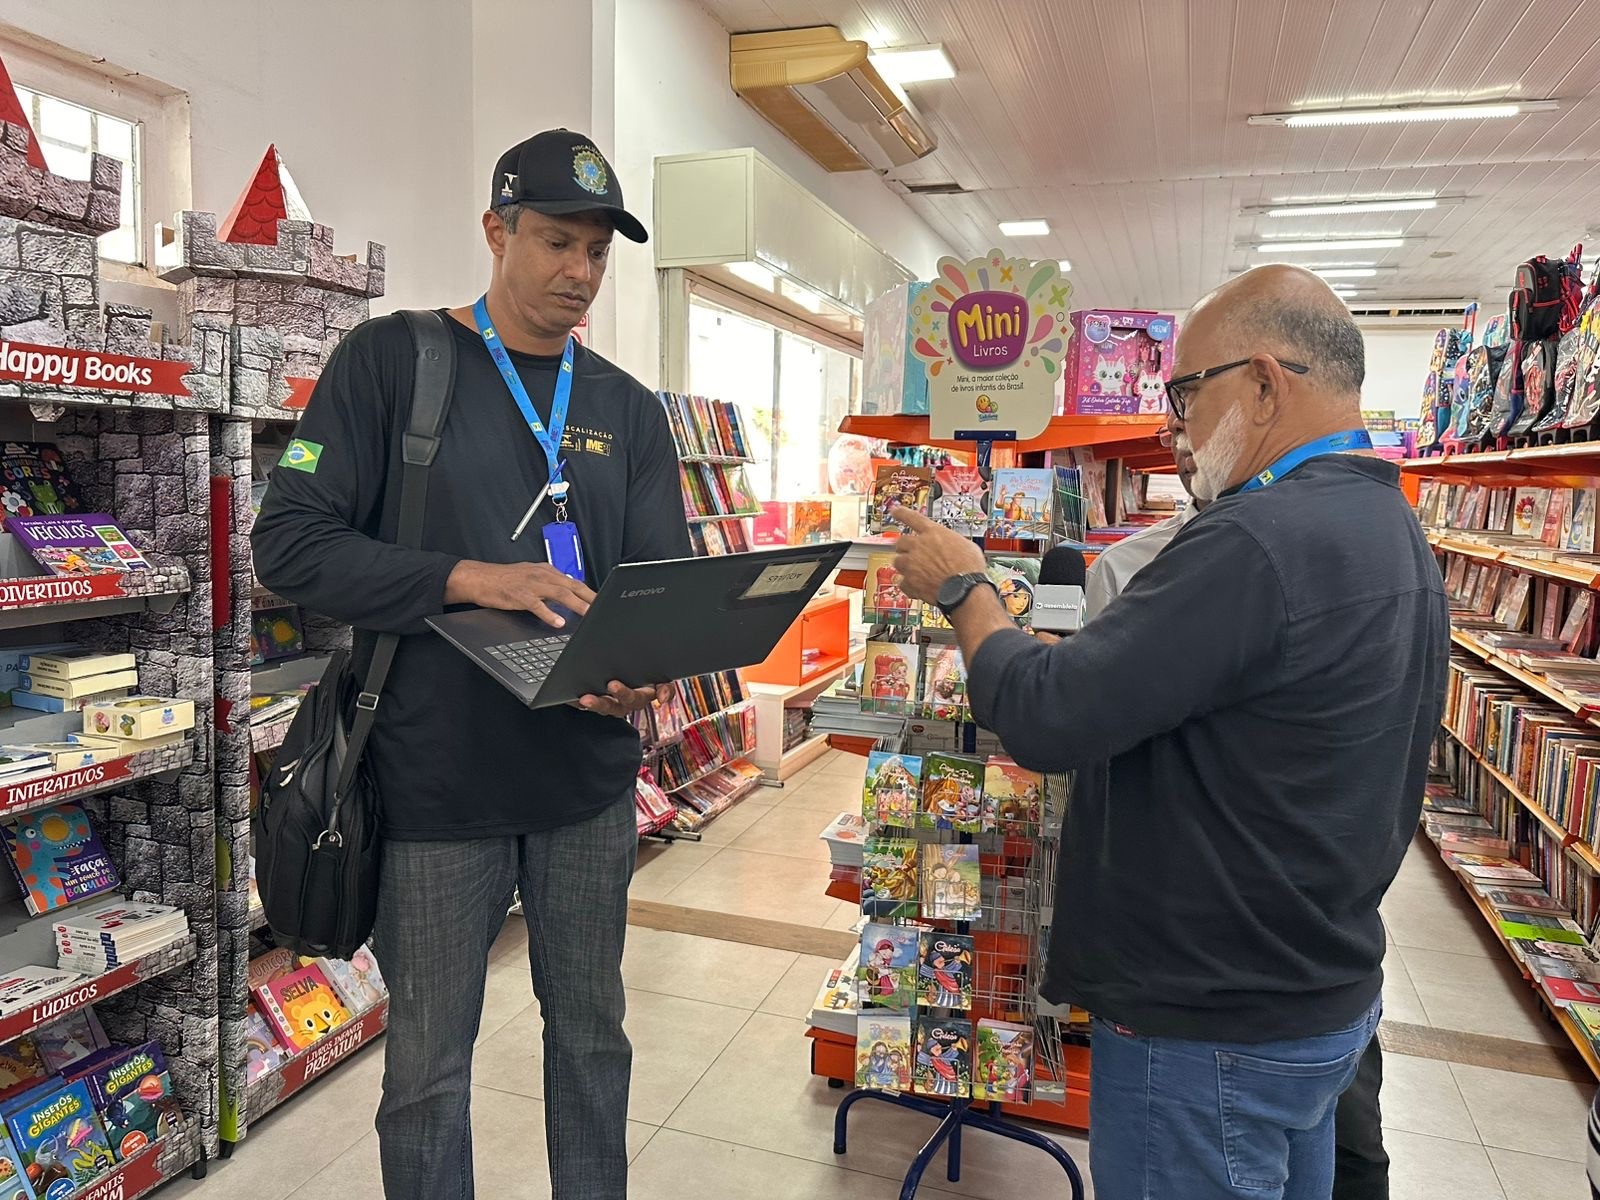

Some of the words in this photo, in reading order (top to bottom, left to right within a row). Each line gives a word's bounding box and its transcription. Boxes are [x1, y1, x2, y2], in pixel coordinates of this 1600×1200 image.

[956, 303, 1020, 348] Mini
[973, 344, 1008, 356] Livros
[85, 357, 152, 386] Books
[995, 373, 1019, 382] coleção
[960, 384, 974, 392] livros
[975, 383, 996, 391] infantis
[997, 382, 1005, 391] do
[565, 425, 613, 440] SCALIZAÇÃO
[4, 466, 51, 480] CORES
[0, 580, 92, 602] DIVERTIDOS
[621, 586, 665, 599] Lenovo
[6, 766, 104, 804] INTERATIVOS
[280, 976, 318, 1002] SELVA
[33, 984, 98, 1023] LÚDICOS
[304, 1030, 362, 1080] PREMIUM
[306, 1041, 333, 1064] LIVROS
[333, 1020, 364, 1046] INFANTIS
[107, 1060, 153, 1093] GIGANTES
[110, 1054, 146, 1081] INSETOS
[29, 1100, 80, 1136] GIGANTES
[32, 1095, 72, 1123] INSETOS
[81, 1173, 125, 1200] FANTIS
